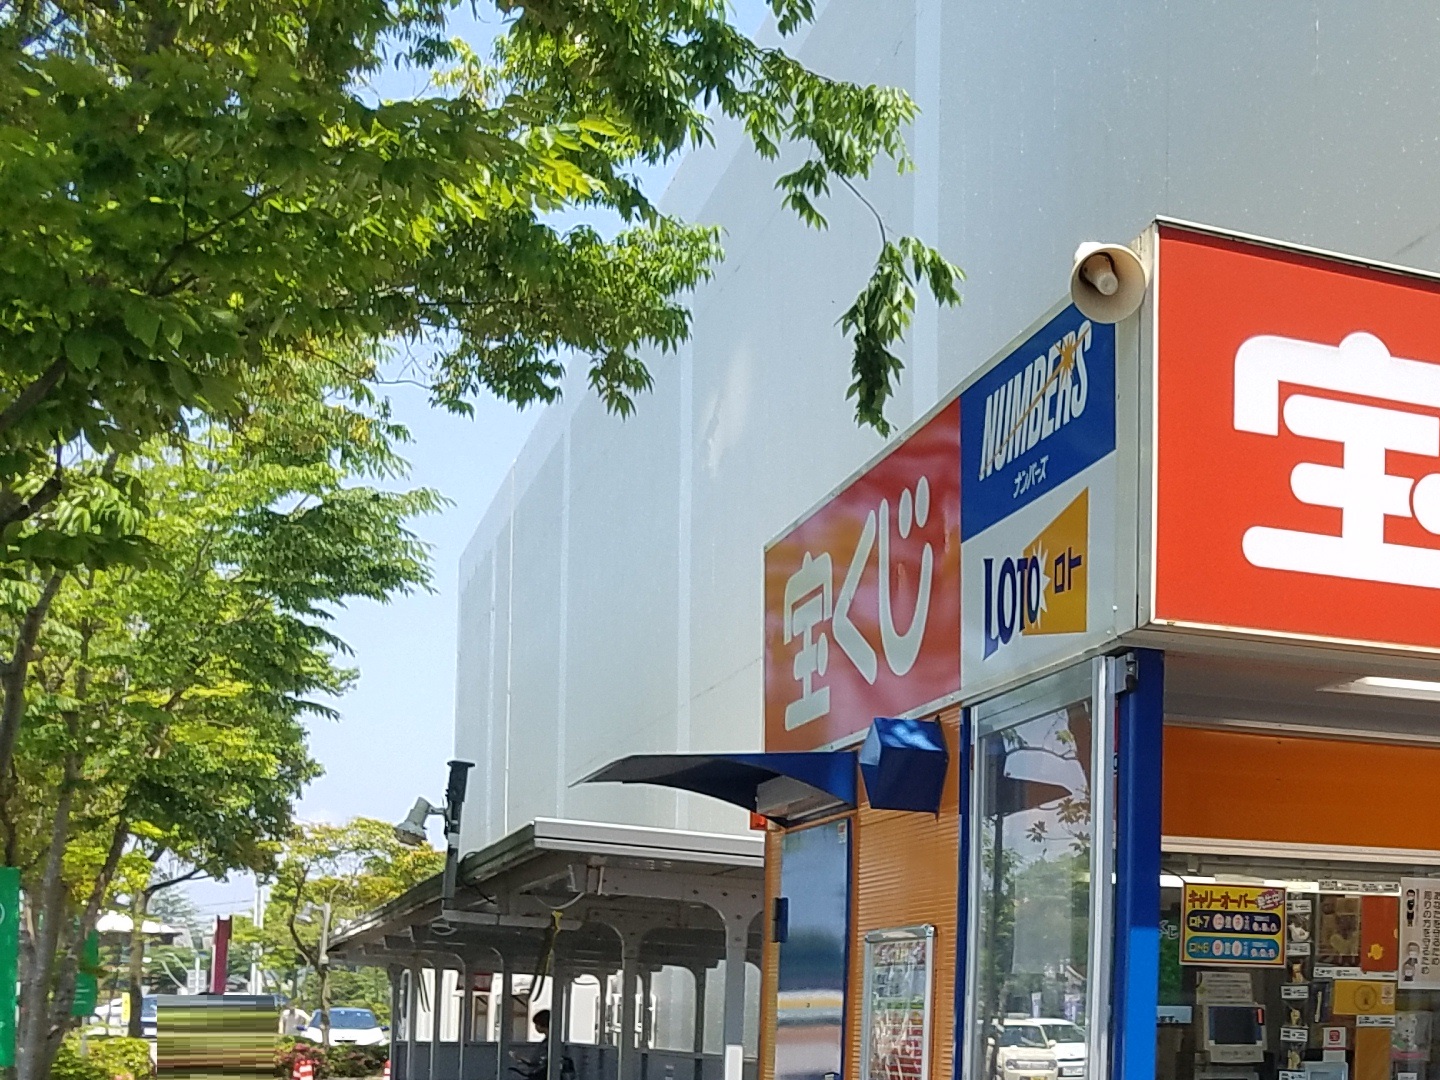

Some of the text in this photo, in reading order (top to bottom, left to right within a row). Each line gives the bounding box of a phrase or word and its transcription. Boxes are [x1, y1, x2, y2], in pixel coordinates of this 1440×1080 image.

[979, 320, 1092, 481] NUMBERS
[1014, 455, 1049, 499] ナンバーズ
[784, 475, 933, 731] 宝くじ
[983, 555, 1042, 661] LOTO
[1054, 547, 1083, 594] ロト
